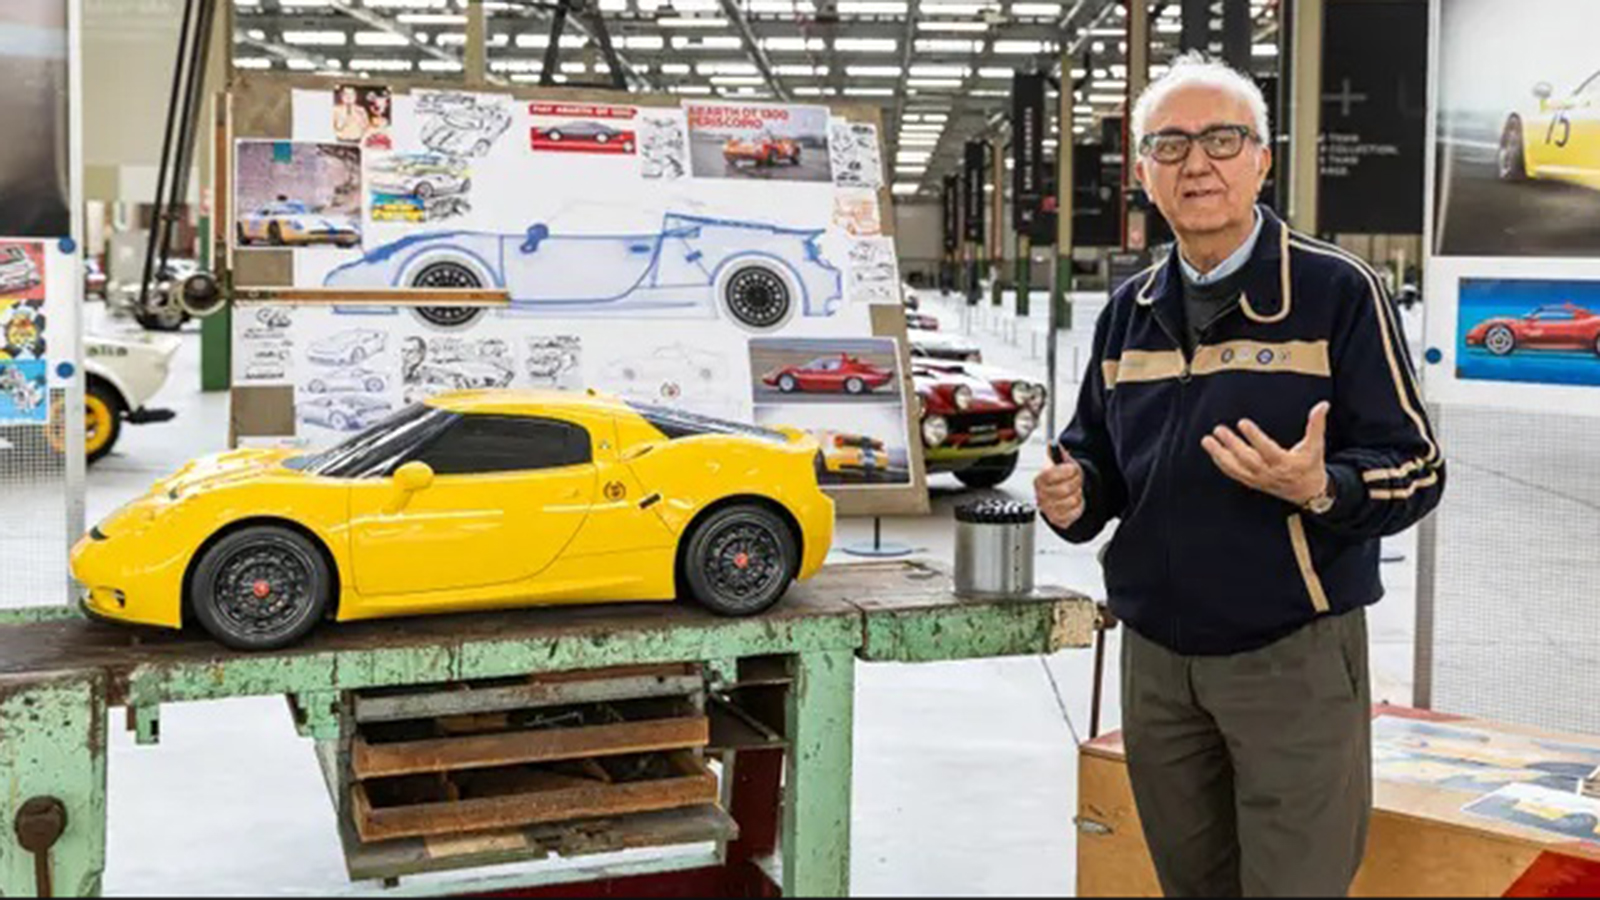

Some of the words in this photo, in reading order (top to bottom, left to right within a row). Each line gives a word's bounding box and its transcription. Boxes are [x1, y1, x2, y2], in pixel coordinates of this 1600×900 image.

[532, 105, 553, 114] FIAT
[555, 106, 593, 115] ABARTH
[689, 105, 740, 117] ABARTH
[689, 115, 763, 129] PERISCOPIO
